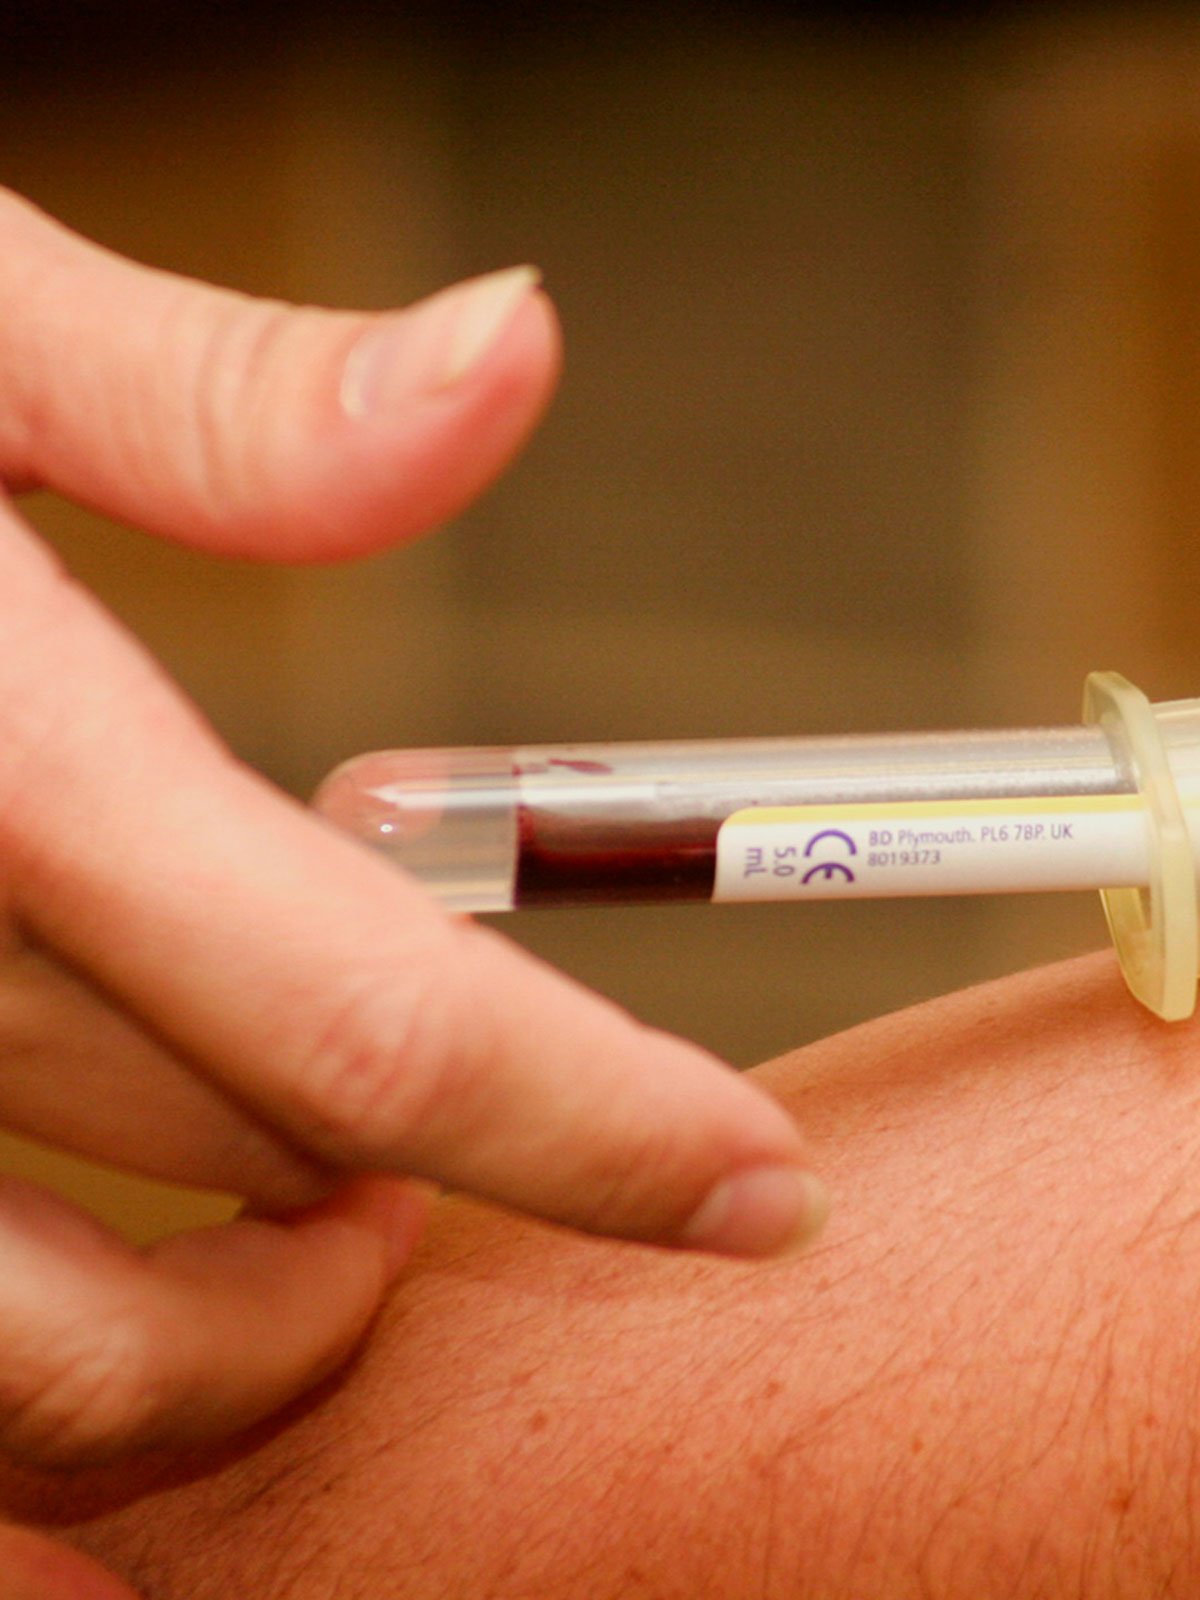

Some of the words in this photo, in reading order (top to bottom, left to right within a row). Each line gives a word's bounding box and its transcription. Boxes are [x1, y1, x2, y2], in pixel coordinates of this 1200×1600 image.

[870, 830, 893, 846] BD
[981, 825, 1009, 842] PL6
[1051, 823, 1074, 840] UK
[773, 847, 796, 876] 5.0
[868, 849, 941, 867] 8019373
